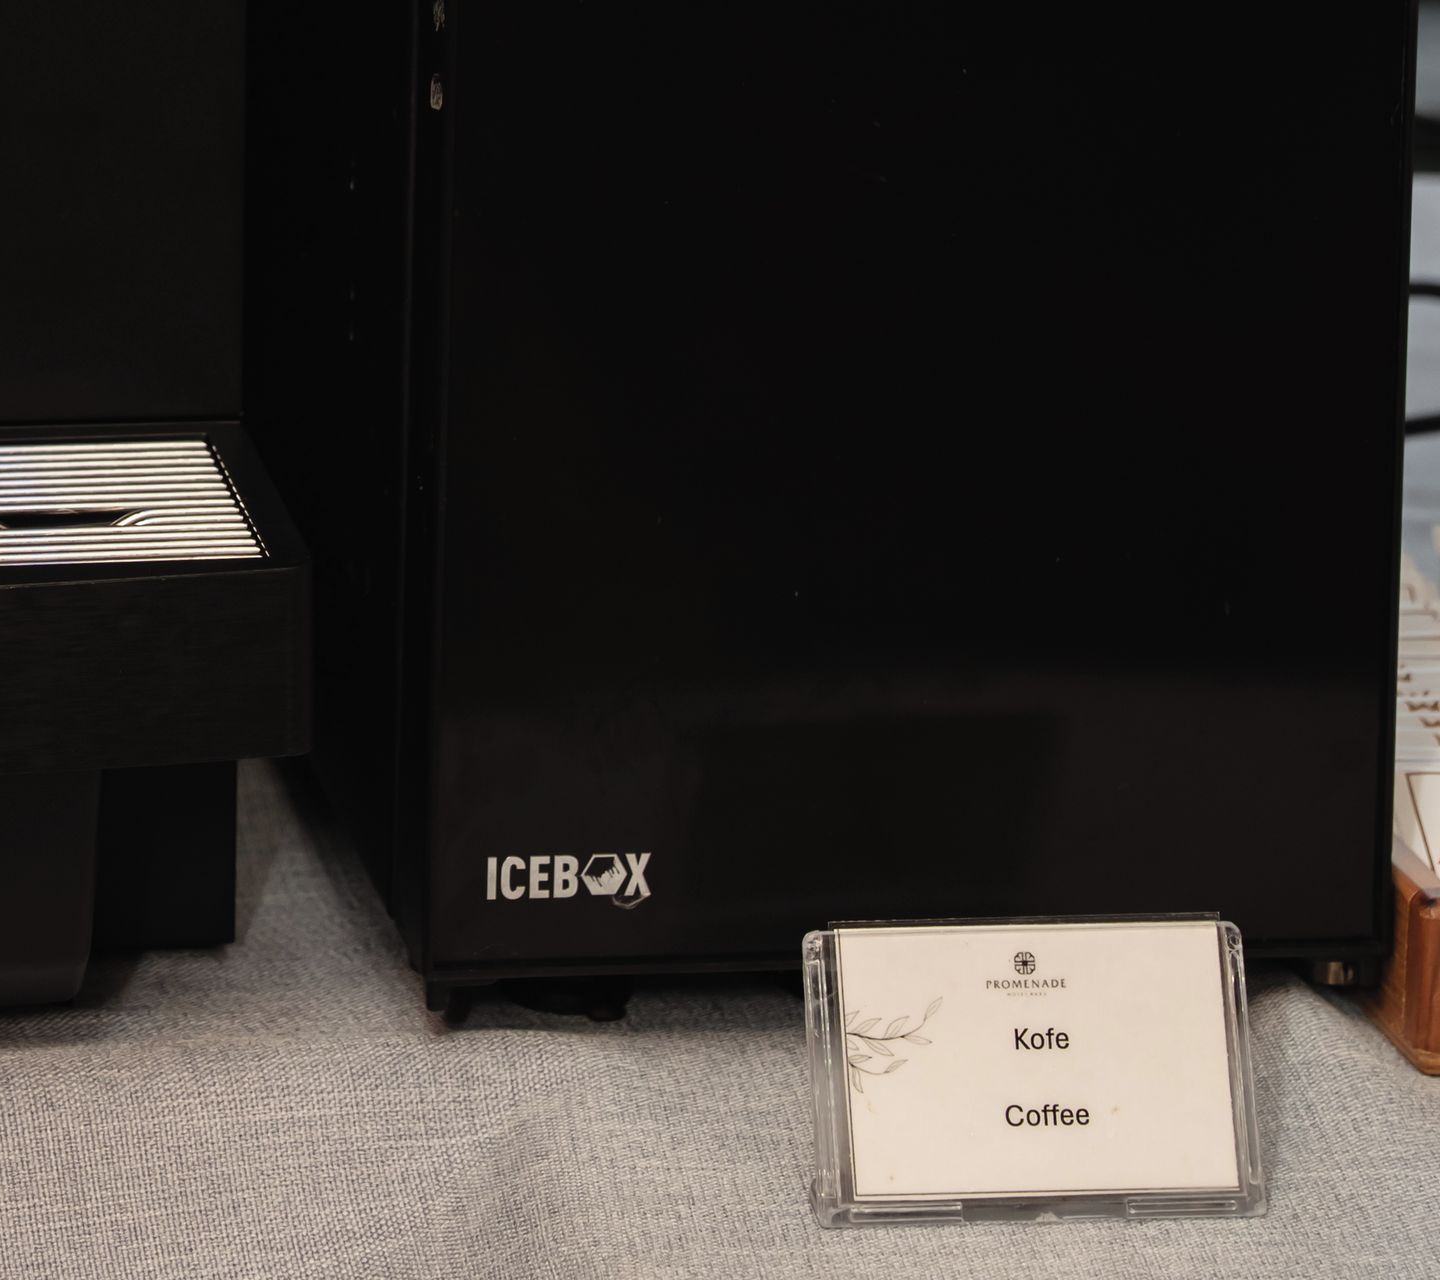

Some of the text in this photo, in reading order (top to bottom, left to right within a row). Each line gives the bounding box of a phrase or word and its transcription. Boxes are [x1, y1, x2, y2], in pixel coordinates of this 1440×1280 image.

[985, 978, 1067, 990] PROMENADE
[1014, 1027, 1070, 1051] Kofe
[1005, 1103, 1090, 1127] Coffee
